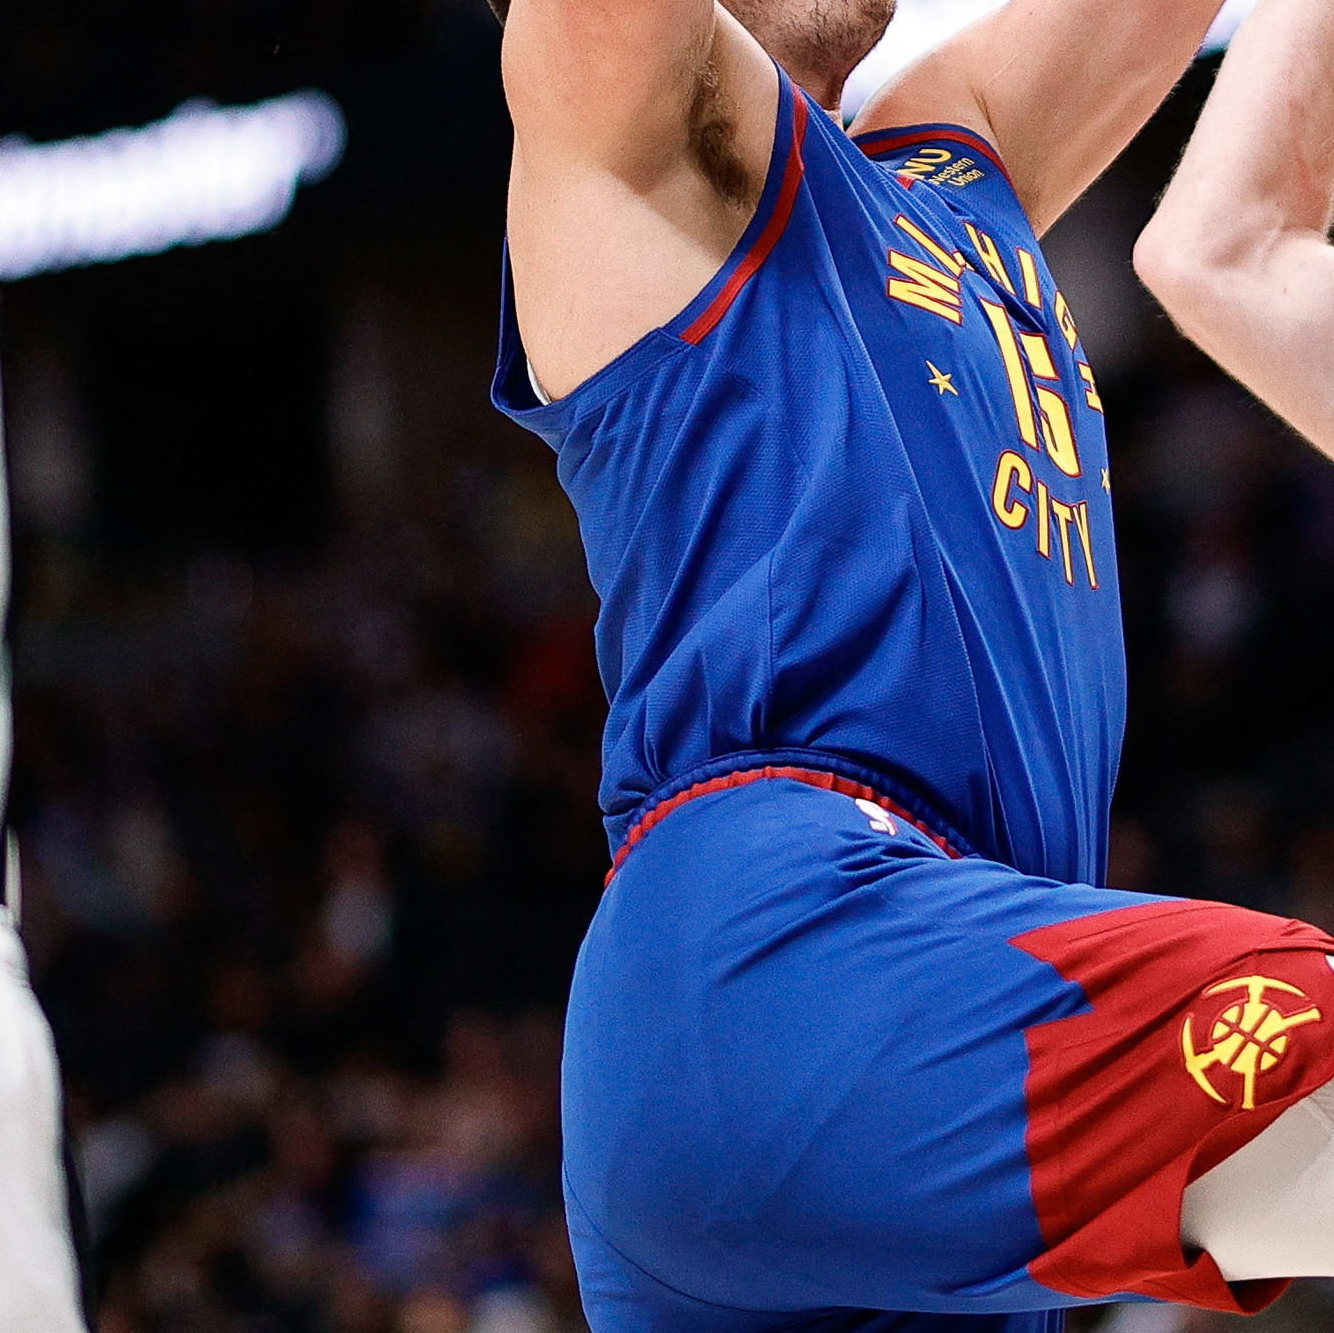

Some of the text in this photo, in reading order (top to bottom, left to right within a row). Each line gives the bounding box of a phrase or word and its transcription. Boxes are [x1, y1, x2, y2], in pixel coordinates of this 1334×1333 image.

[947, 168, 986, 187] Union
[978, 296, 1082, 478] 15
[992, 448, 1100, 590] CITY
